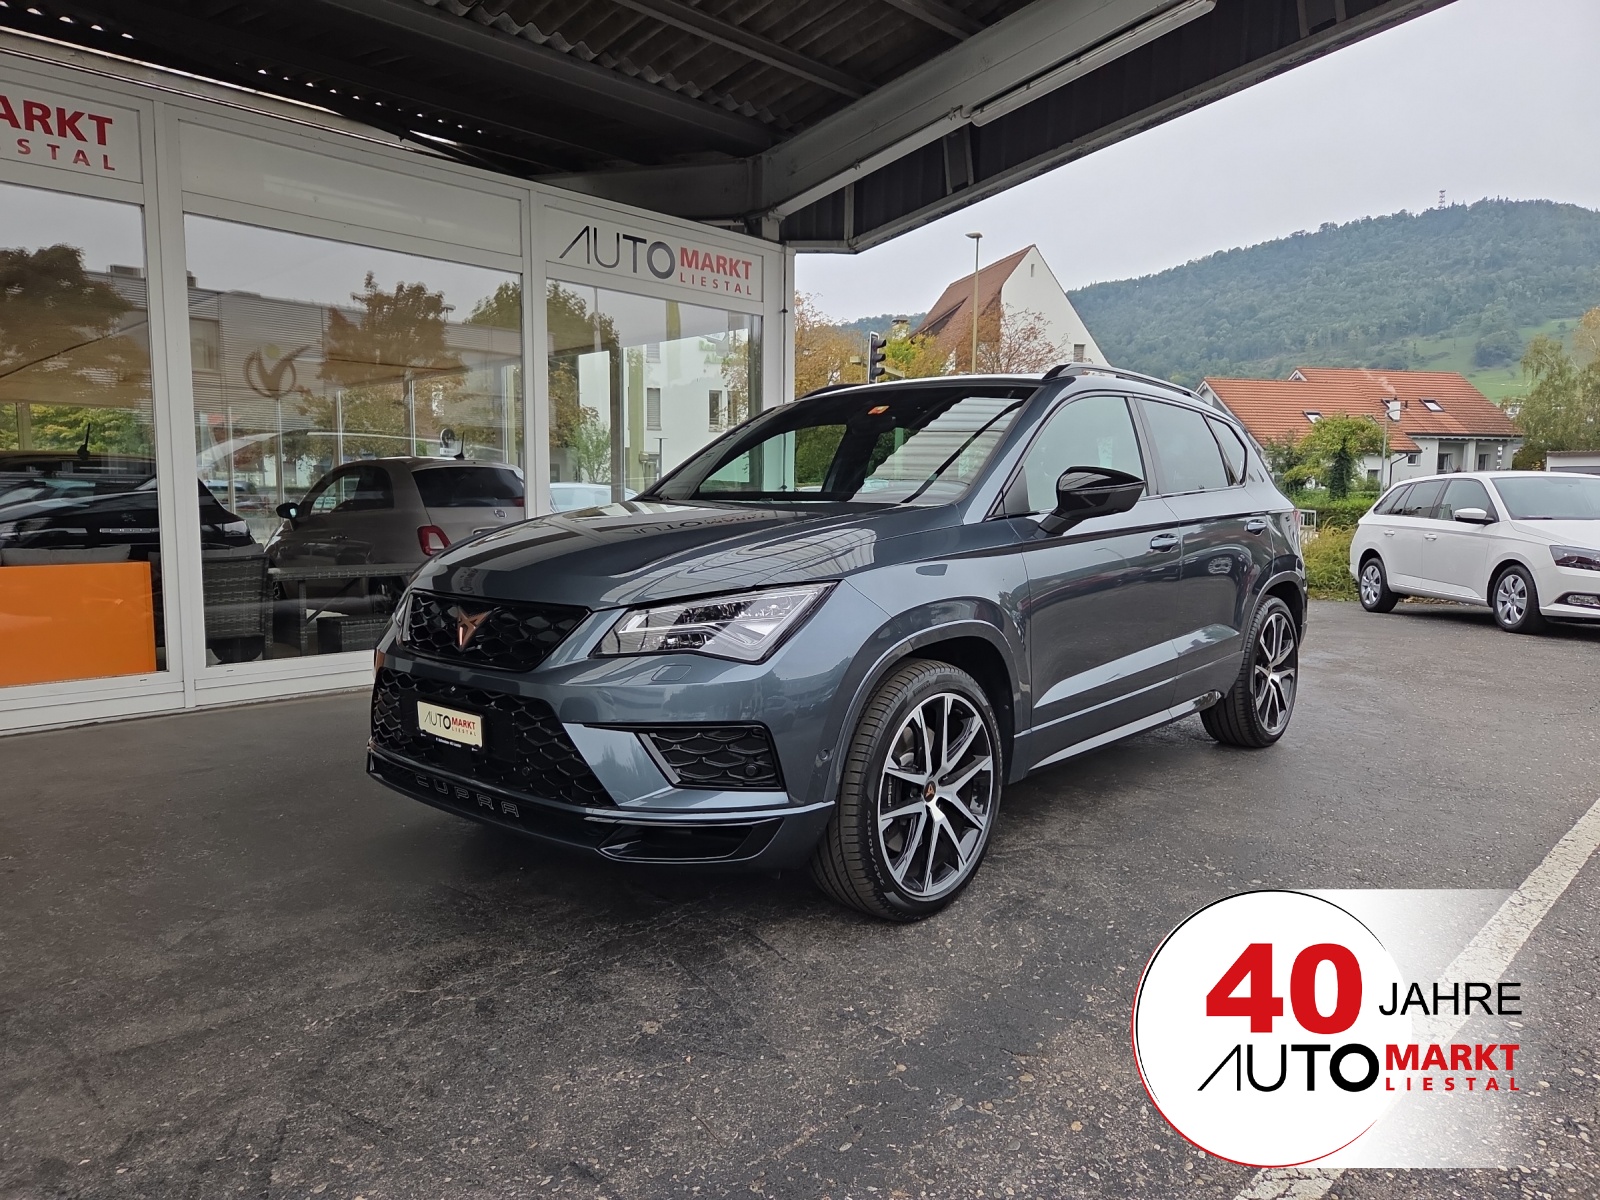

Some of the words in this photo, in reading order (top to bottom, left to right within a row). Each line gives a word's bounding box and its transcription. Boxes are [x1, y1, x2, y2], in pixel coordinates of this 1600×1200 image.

[559, 225, 676, 279] AUTO
[680, 247, 752, 280] MARKT
[680, 272, 752, 295] LIESTAL
[424, 711, 451, 730] AUTO
[451, 716, 476, 730] MARKT
[415, 773, 520, 818] CUPRA
